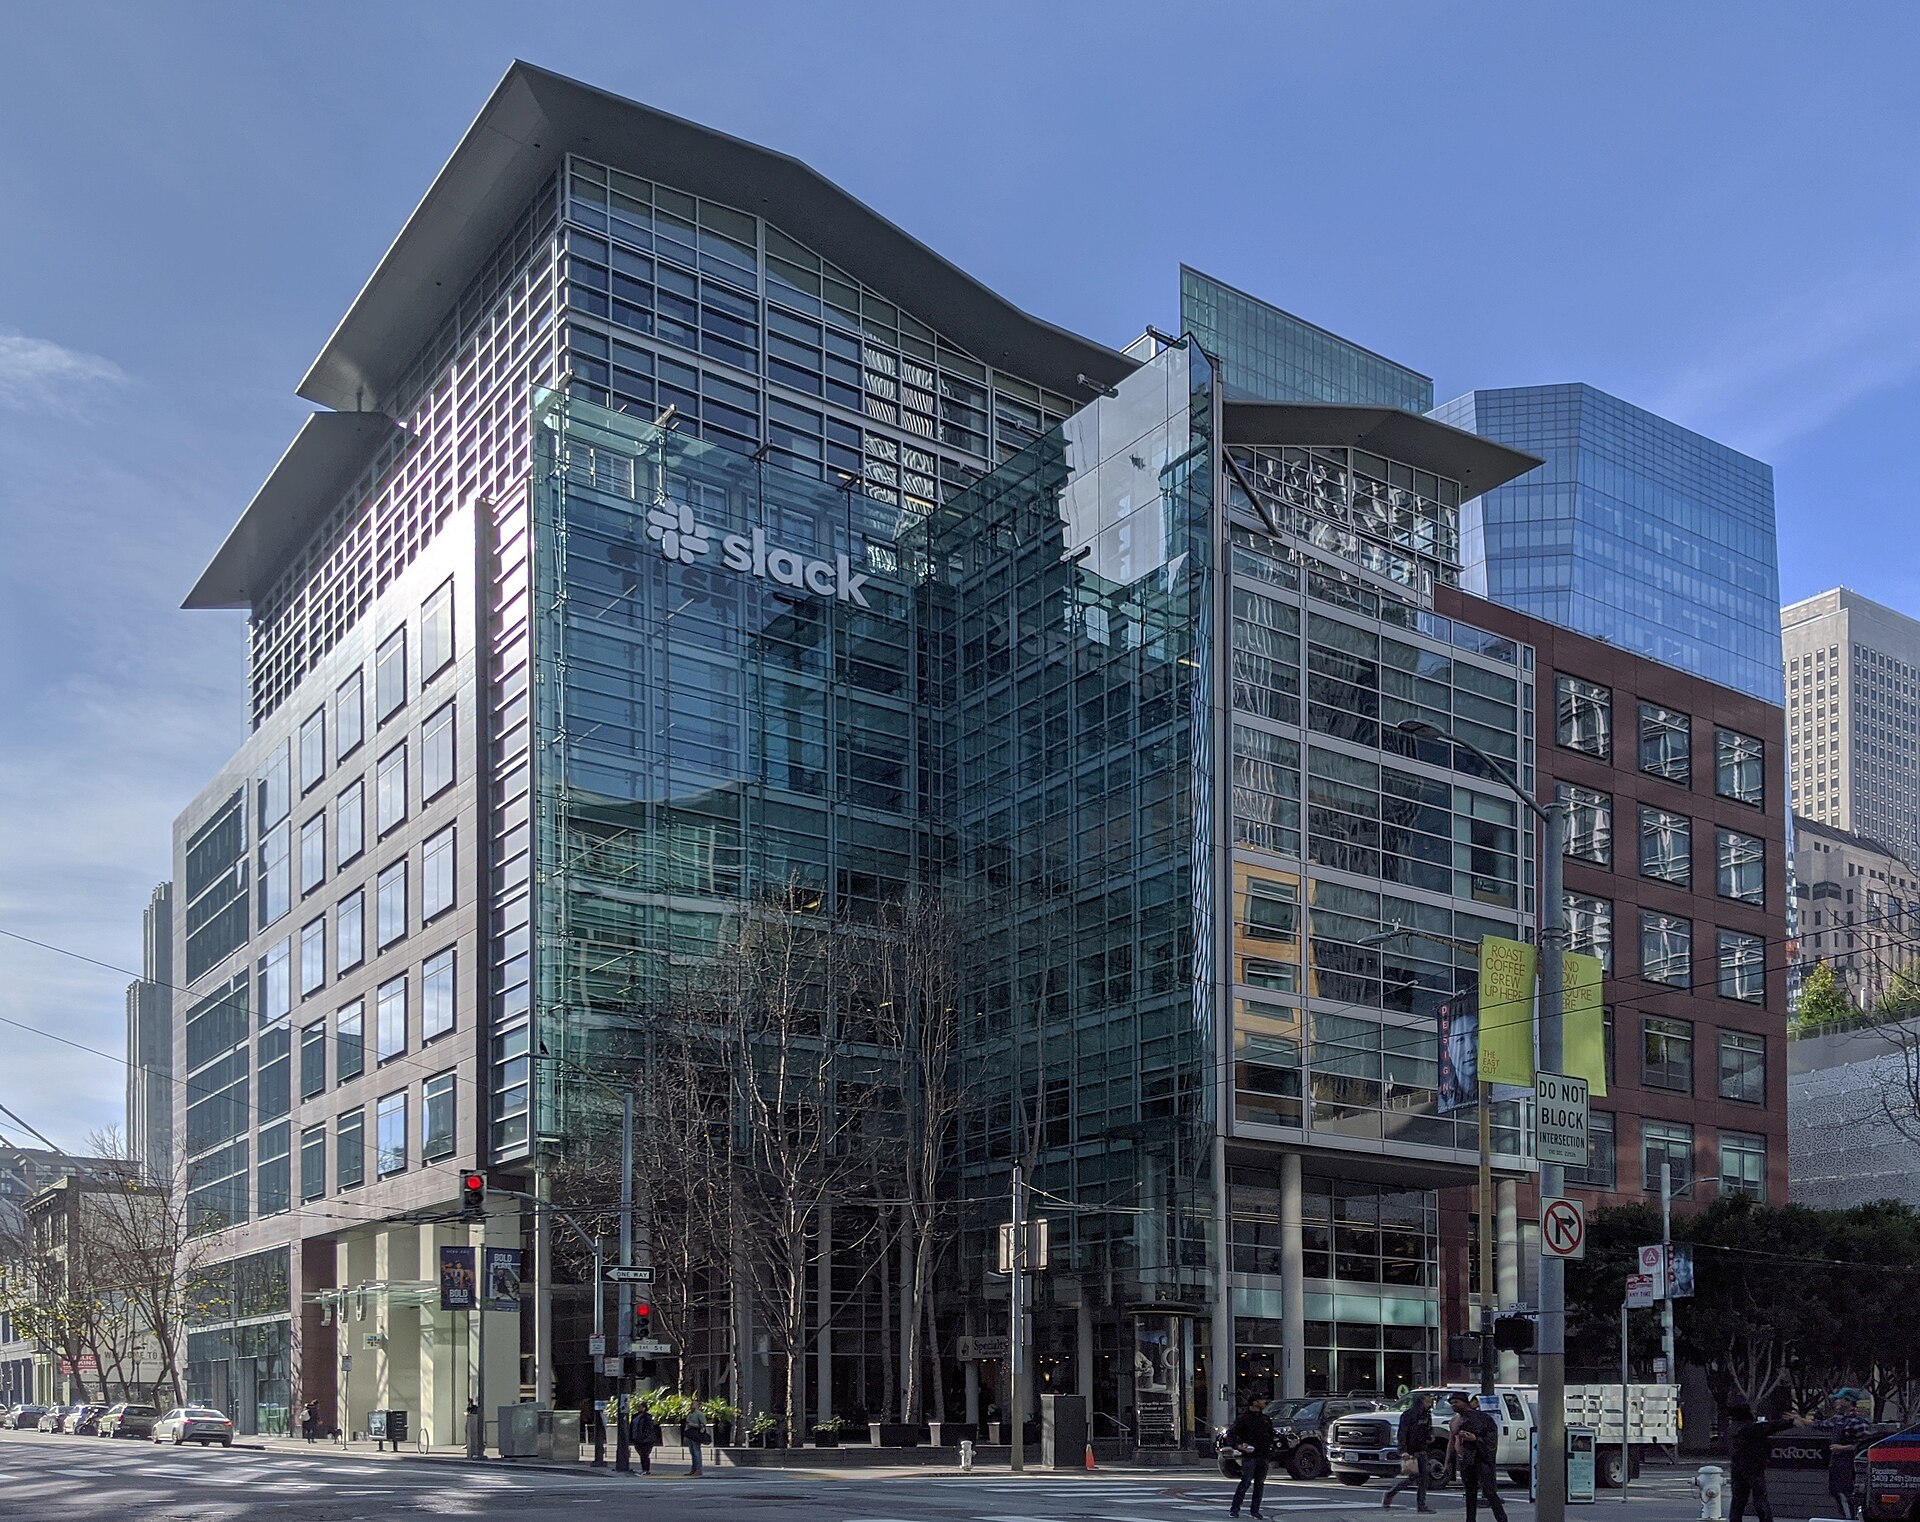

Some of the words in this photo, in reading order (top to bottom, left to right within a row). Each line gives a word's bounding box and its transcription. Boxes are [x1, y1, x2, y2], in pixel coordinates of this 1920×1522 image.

[722, 527, 871, 608] slack
[1491, 944, 1525, 961] ROAST
[1485, 957, 1526, 977] COFFEE
[1490, 972, 1521, 989] GREW
[1562, 971, 1578, 985] OW
[1484, 984, 1498, 997] UP
[1500, 987, 1525, 1004] HERE
[1562, 997, 1577, 1010] RE
[1441, 1005, 1450, 1095] DESIGN
[1483, 1049, 1496, 1059] THE
[1482, 1058, 1500, 1067] EAST
[1482, 1066, 1497, 1075] CUT
[1539, 1080, 1556, 1100] DO
[1562, 1084, 1586, 1104] NOT
[1541, 1107, 1583, 1130] BLOCK
[1539, 1131, 1585, 1149] INTERSECTION
[494, 1253, 513, 1262] BOLD
[449, 1289, 469, 1298] BOLD
